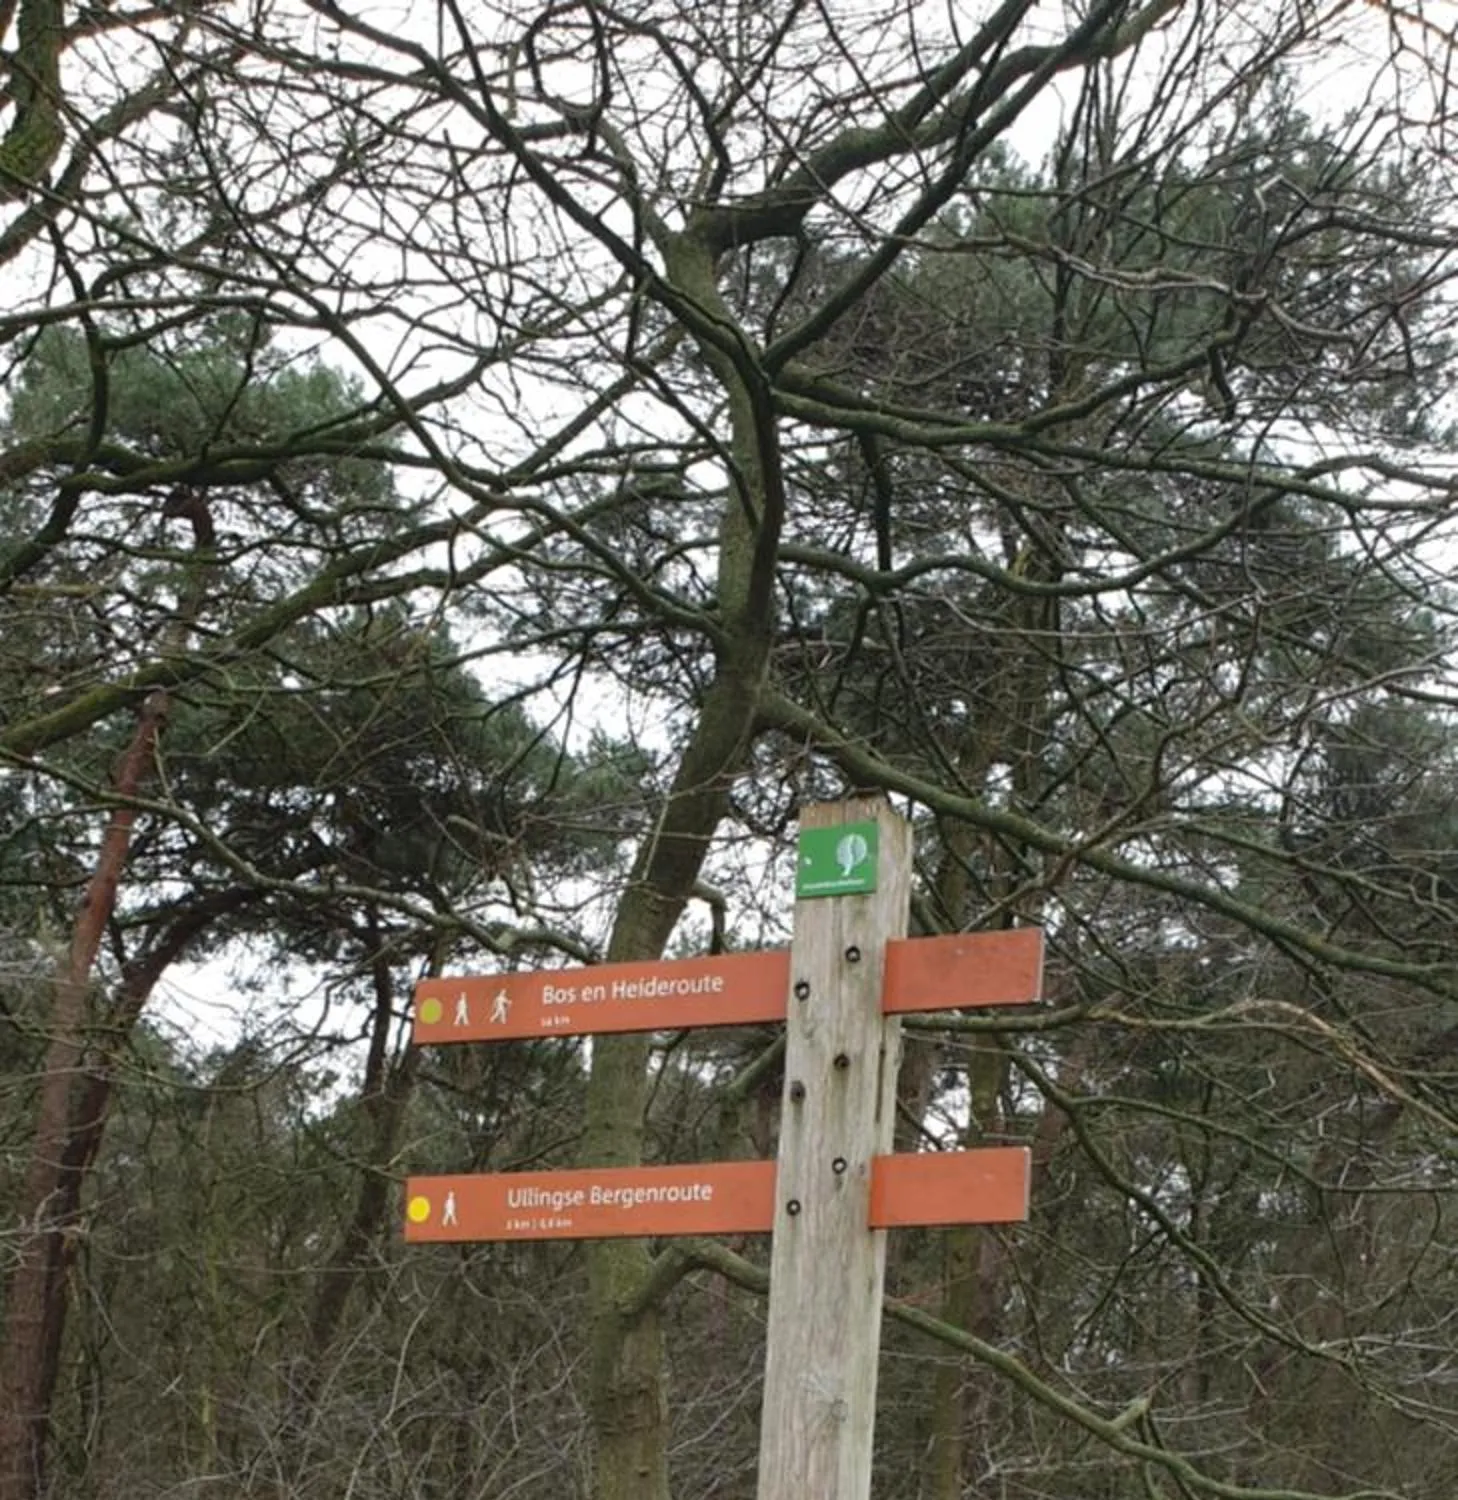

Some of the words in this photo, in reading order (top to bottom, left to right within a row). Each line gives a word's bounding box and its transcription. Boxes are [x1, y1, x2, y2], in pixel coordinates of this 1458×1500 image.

[543, 985, 577, 1005] Bos
[581, 985, 606, 1002] en
[611, 975, 724, 998] Heideroute
[507, 1187, 585, 1211] Ullingse
[589, 1184, 713, 1208] Bergenroute
